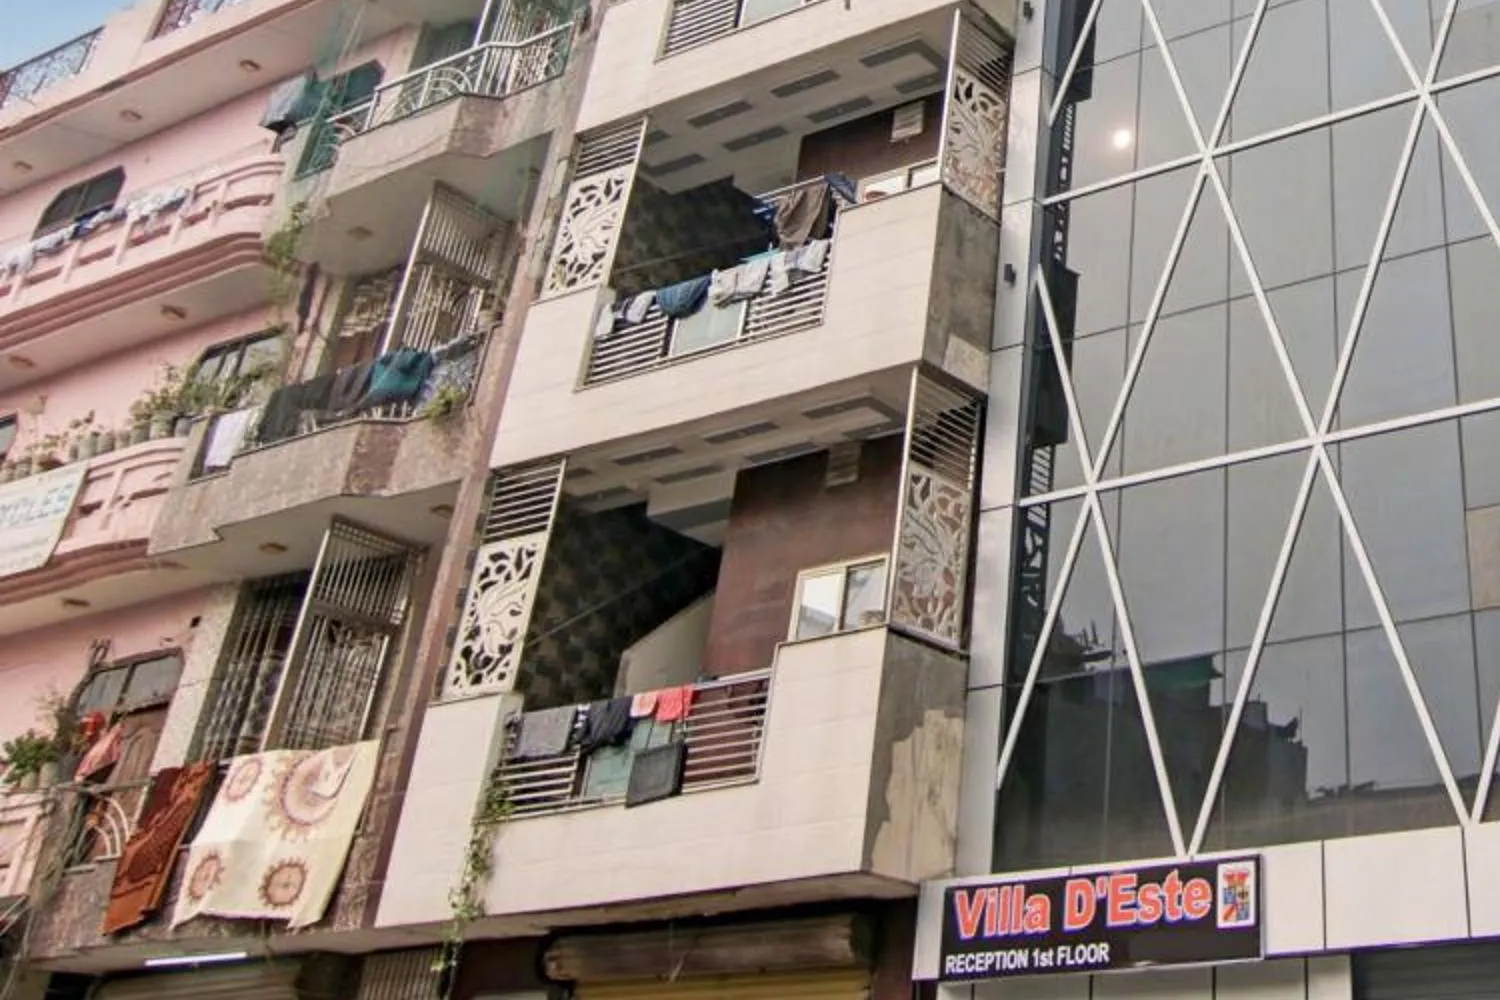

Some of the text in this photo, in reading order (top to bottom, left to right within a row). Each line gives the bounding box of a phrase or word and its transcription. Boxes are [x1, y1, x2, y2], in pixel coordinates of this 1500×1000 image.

[954, 868, 1213, 941] Villa D'Este
[945, 942, 1110, 974] RECEPTION 1st FLOOR
